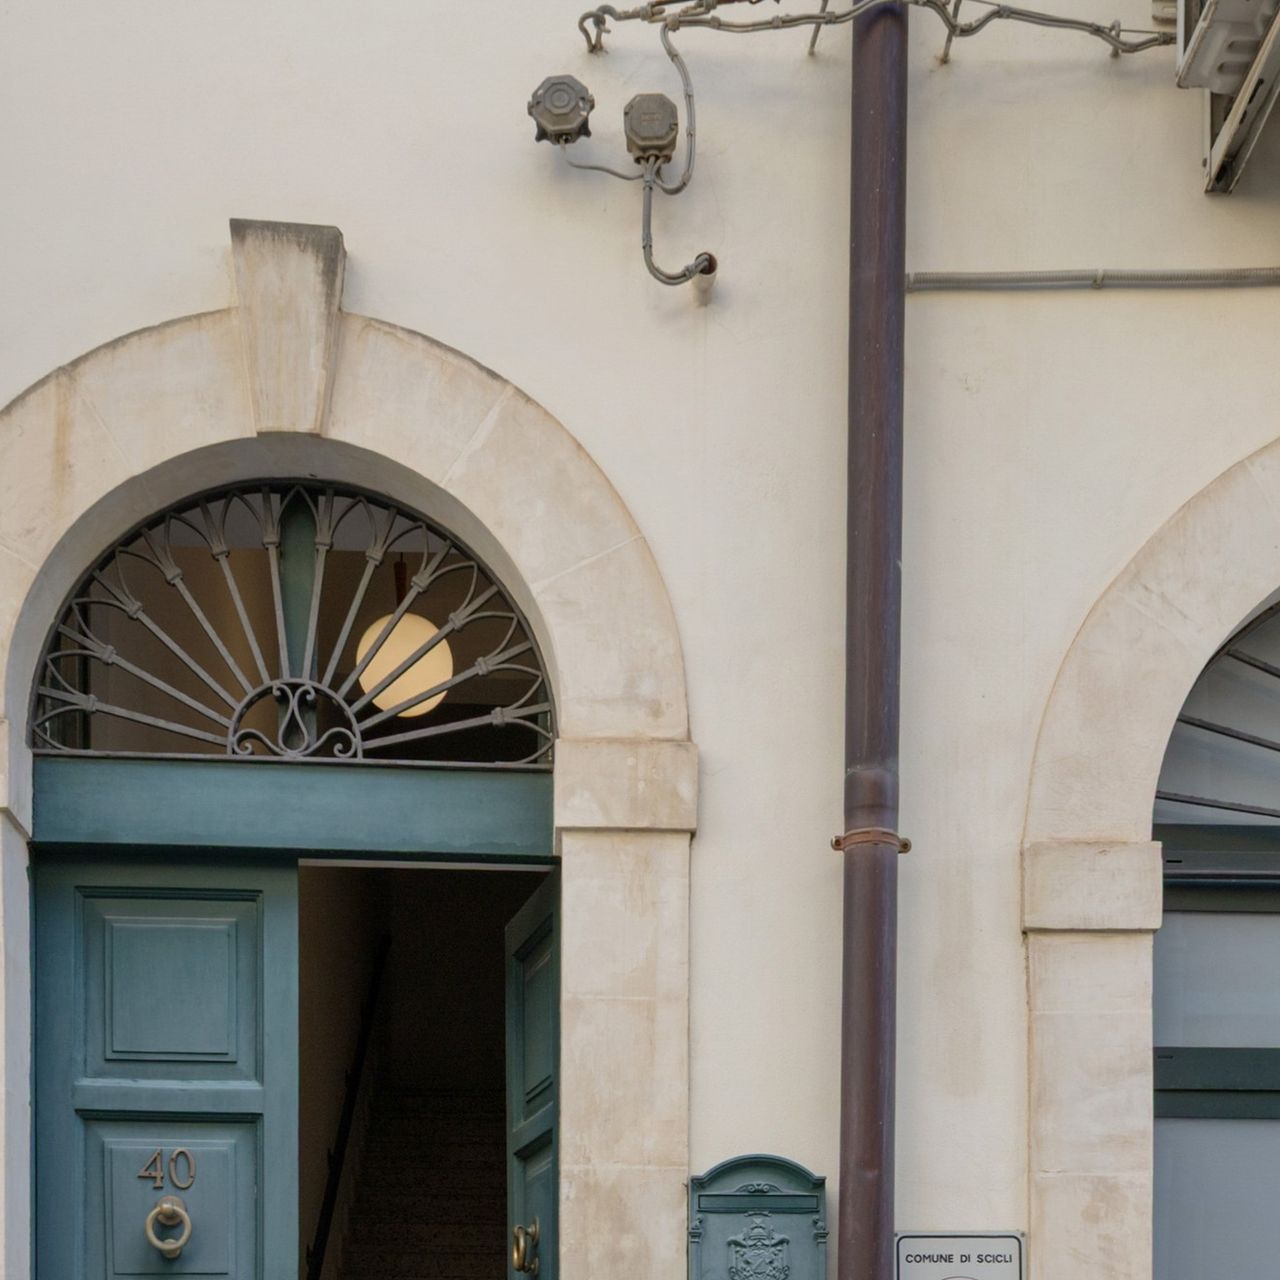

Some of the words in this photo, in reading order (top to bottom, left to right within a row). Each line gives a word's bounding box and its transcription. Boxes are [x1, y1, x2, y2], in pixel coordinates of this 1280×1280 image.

[137, 1147, 196, 1190] 40
[905, 1254, 954, 1263] COMUNE
[960, 1254, 971, 1263] DI
[976, 1254, 1013, 1263] SCICLI
